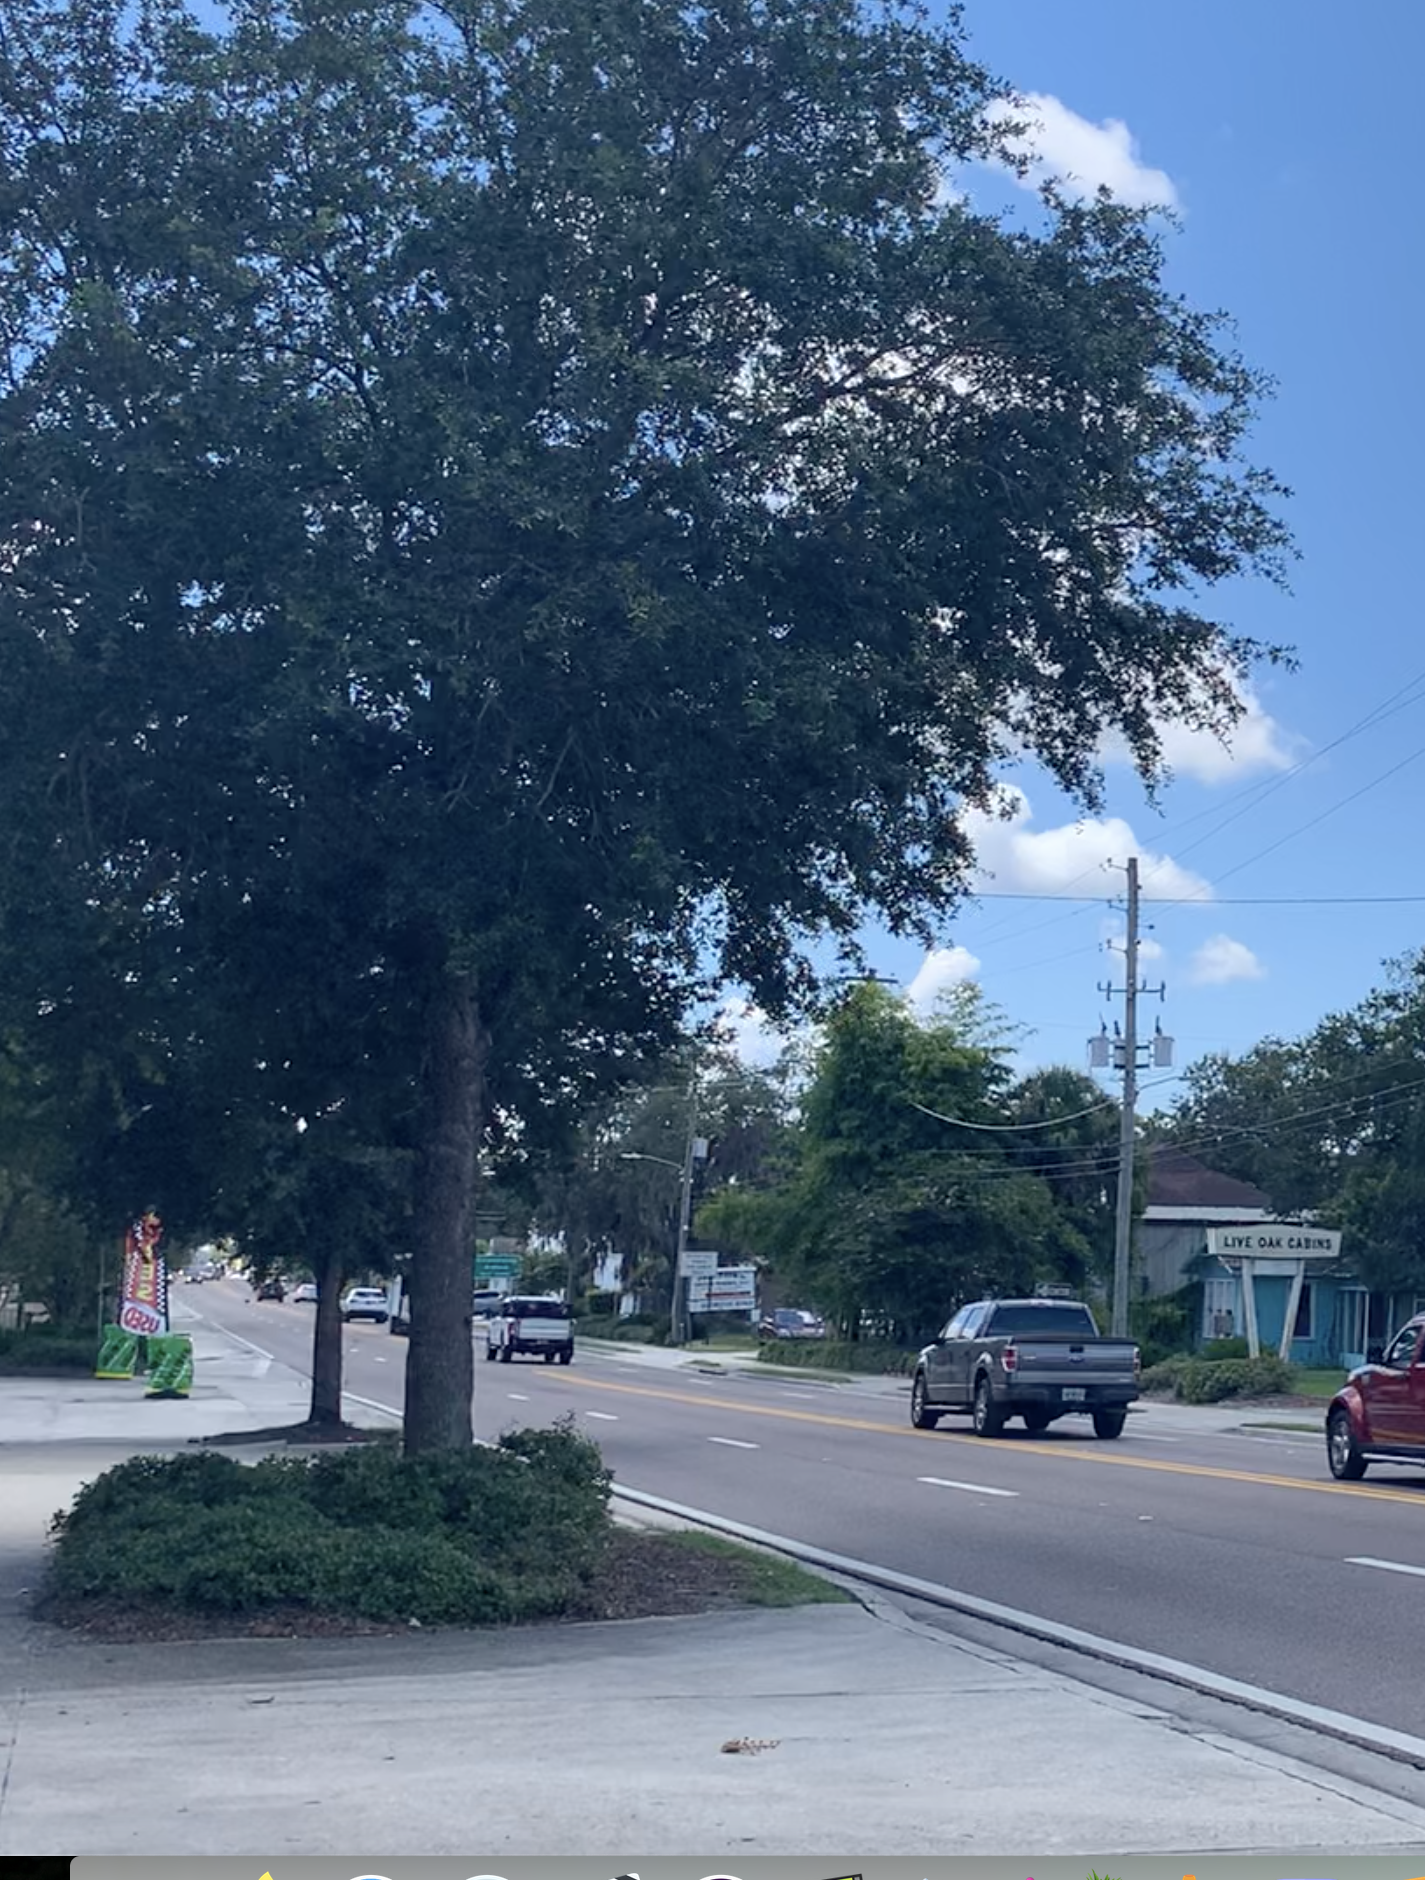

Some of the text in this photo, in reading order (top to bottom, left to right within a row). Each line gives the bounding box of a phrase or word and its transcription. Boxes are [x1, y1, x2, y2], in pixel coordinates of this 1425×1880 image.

[1224, 1236, 1332, 1250] LIVE OAK CABINS
